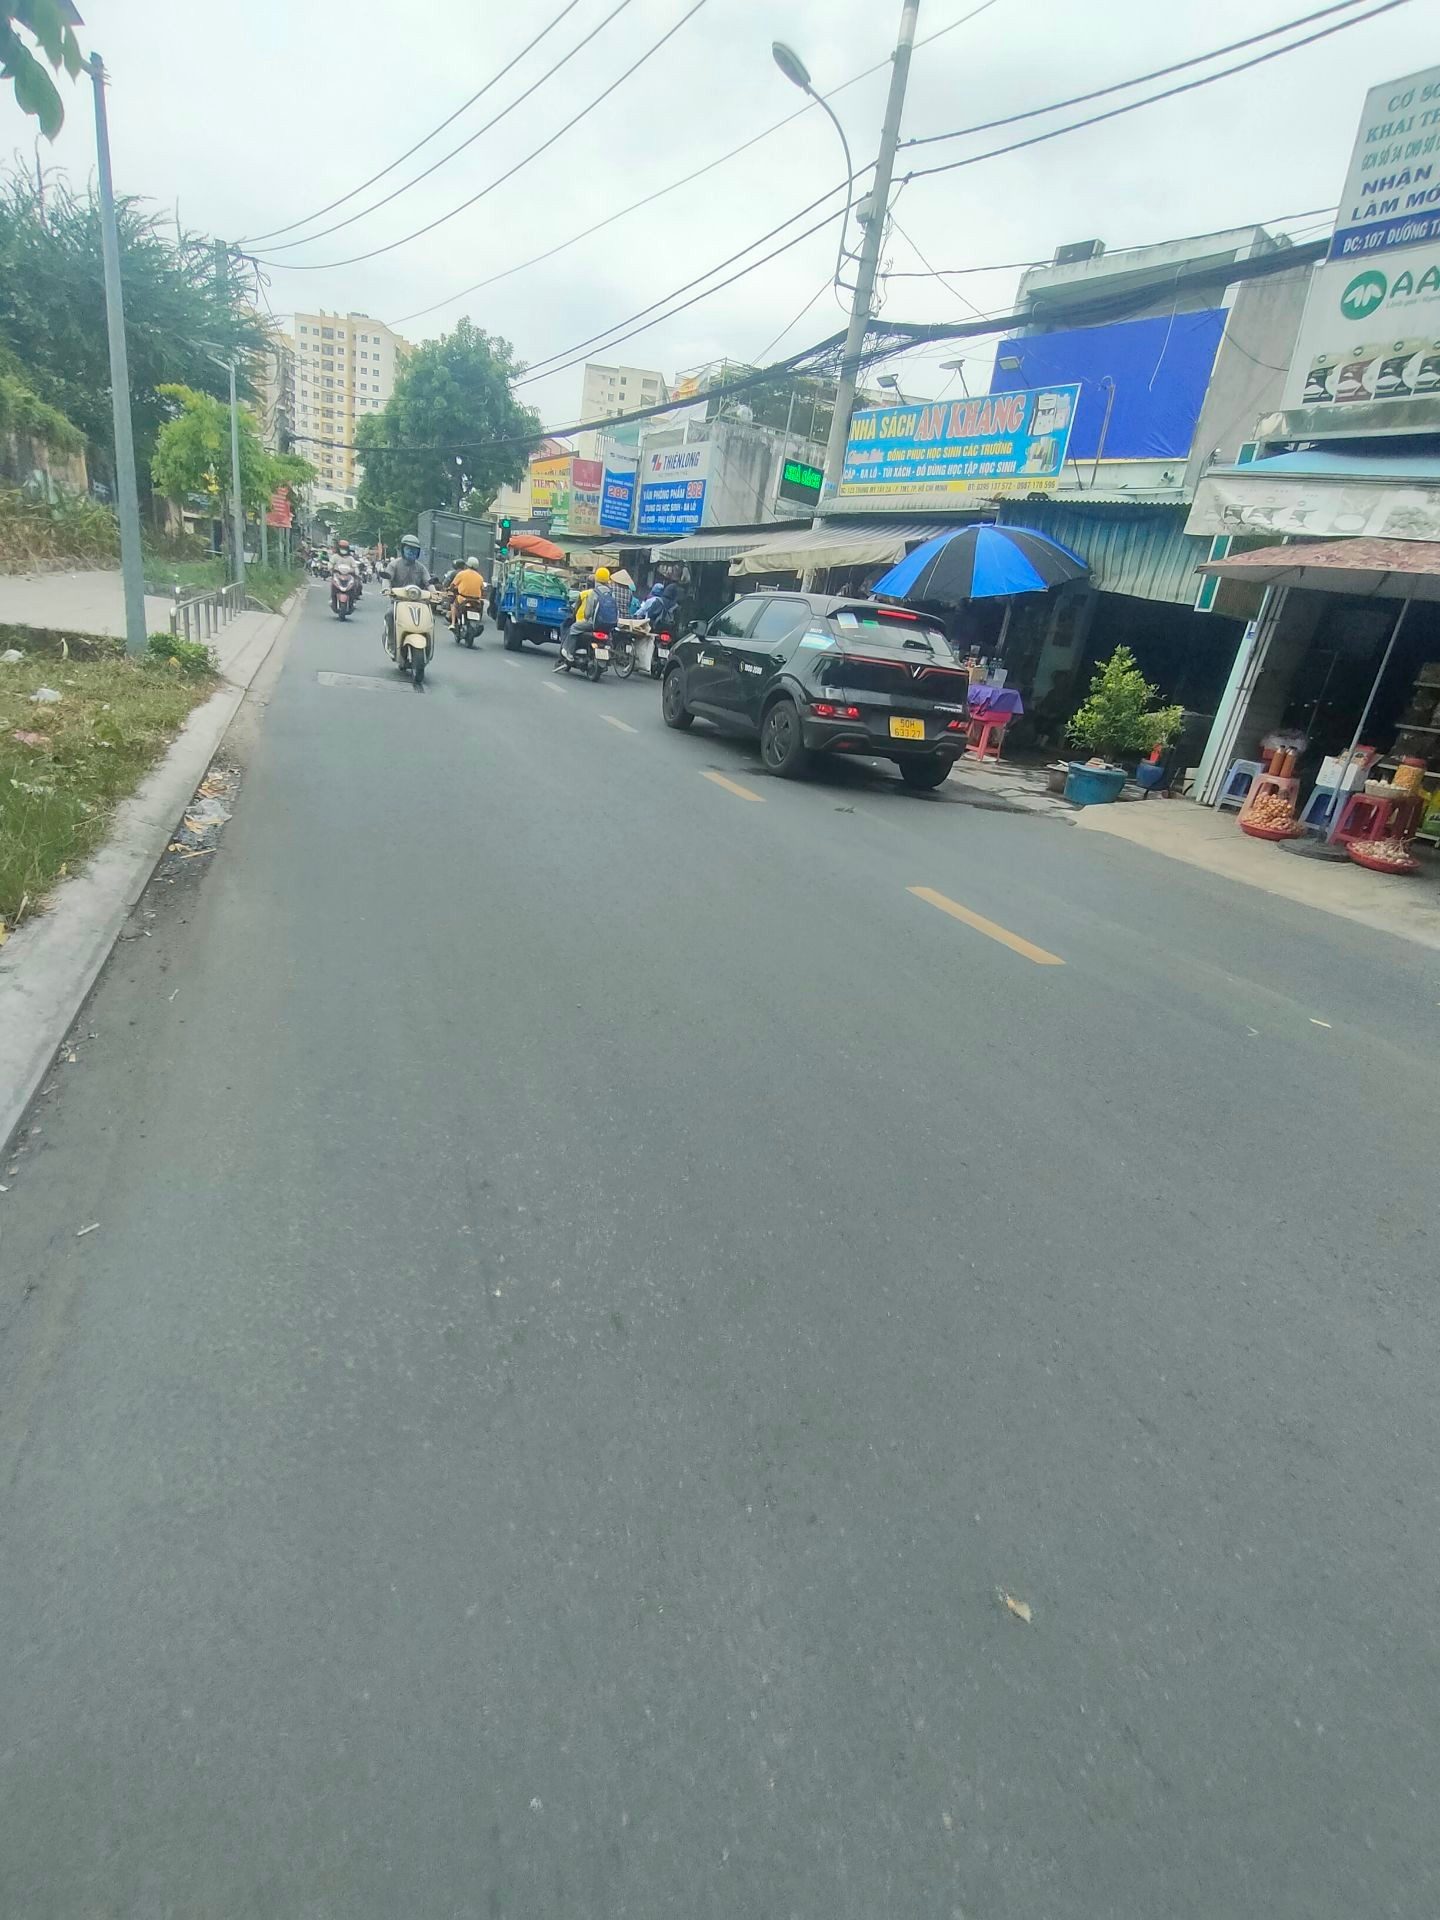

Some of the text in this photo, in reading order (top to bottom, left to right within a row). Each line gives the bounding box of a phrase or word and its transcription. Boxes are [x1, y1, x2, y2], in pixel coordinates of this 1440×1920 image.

[1366, 115, 1415, 144] KHAI
[1361, 163, 1433, 197] NHẬN
[1351, 197, 1400, 221] LÀM
[850, 395, 1026, 441] NHÀ SÁCH AN KHANG
[943, 445, 962, 458] SINH
[962, 444, 979, 457] CÁC
[893, 464, 912, 478] XÁCH
[963, 462, 978, 476] TẬP
[979, 462, 996, 475] HỌC
[996, 460, 1017, 473] SINH
[607, 485, 629, 501] 282
[899, 718, 915, 729] 50H
